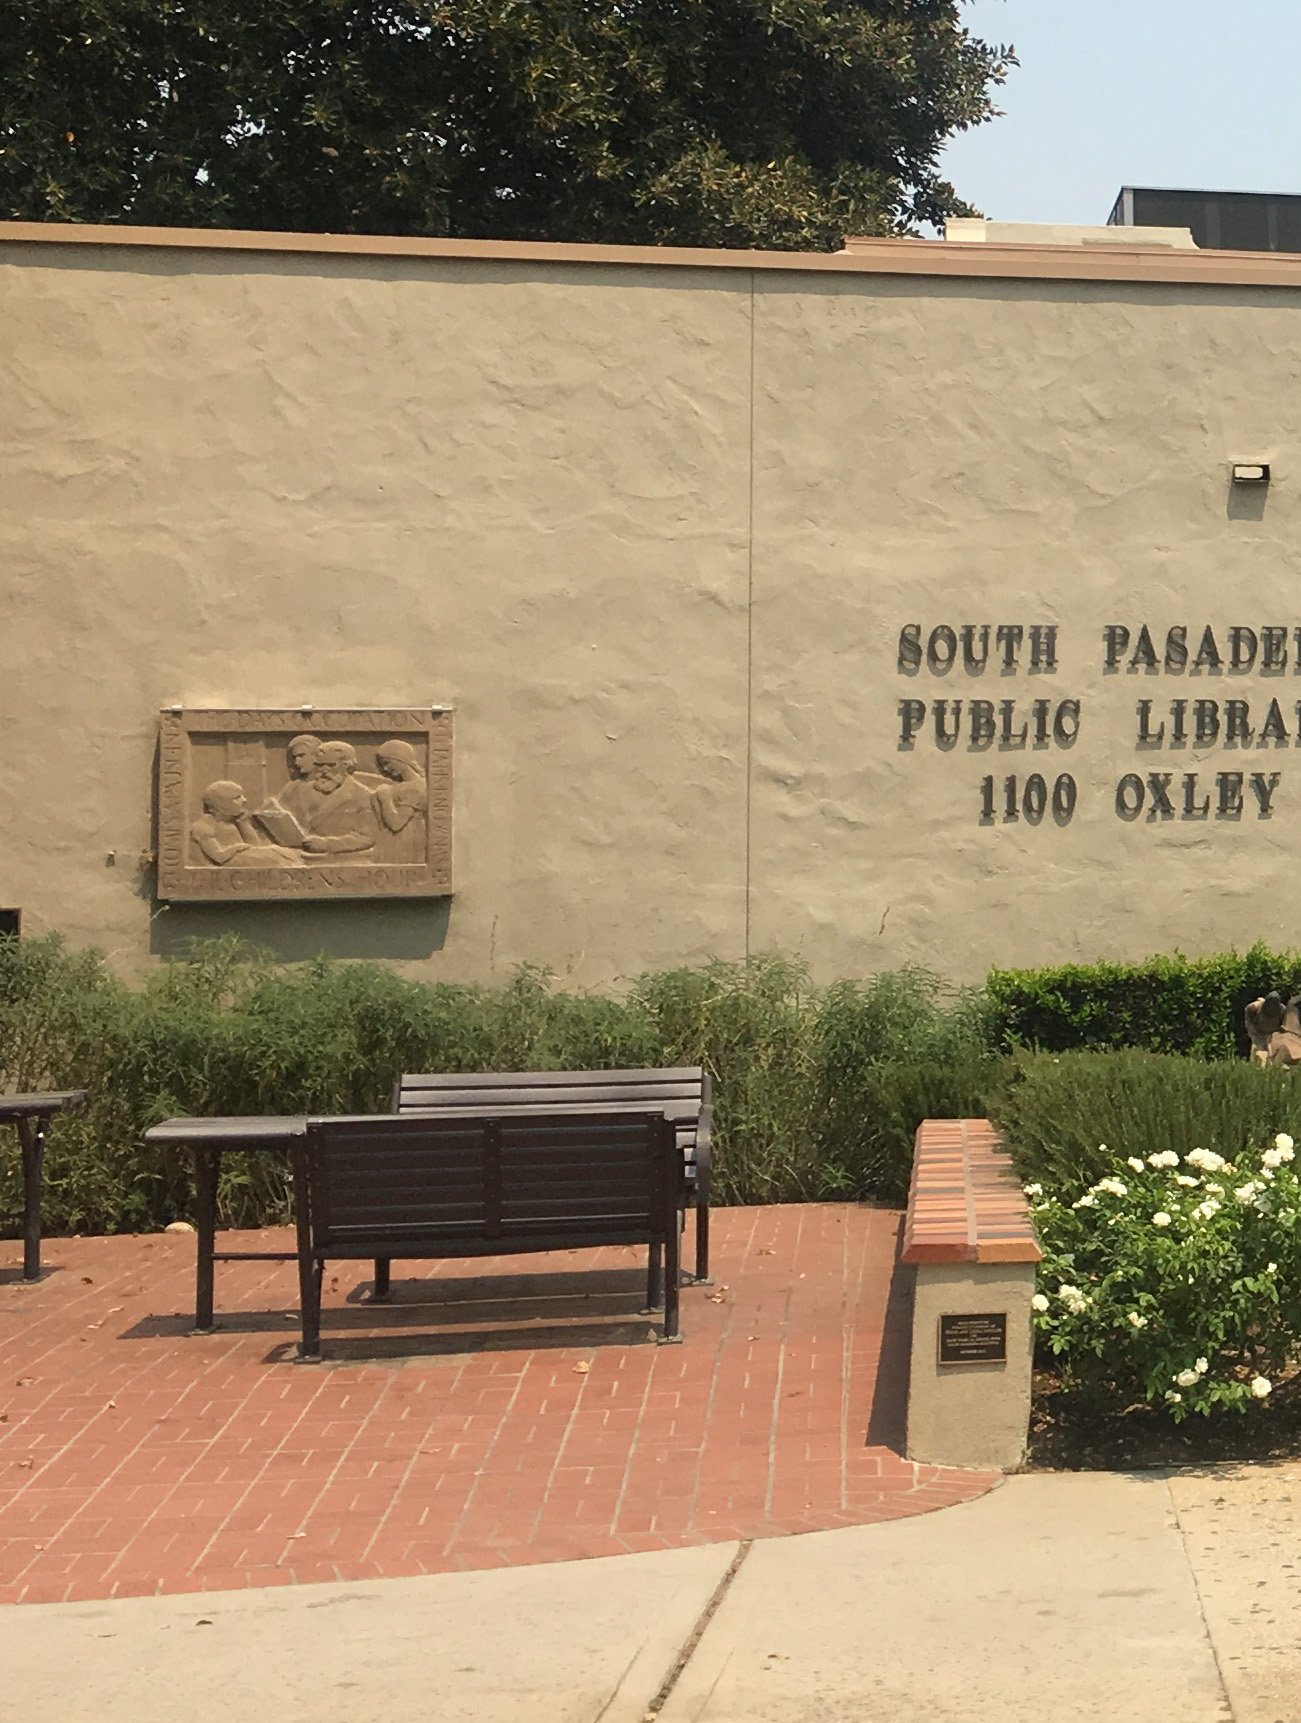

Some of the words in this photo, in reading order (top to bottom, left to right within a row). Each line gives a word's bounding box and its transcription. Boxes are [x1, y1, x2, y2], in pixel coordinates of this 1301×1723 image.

[898, 623, 1058, 673] SOUTH
[898, 698, 1082, 747] PUBLIC
[979, 772, 1077, 823] 1100
[1115, 771, 1282, 820] OXLEY
